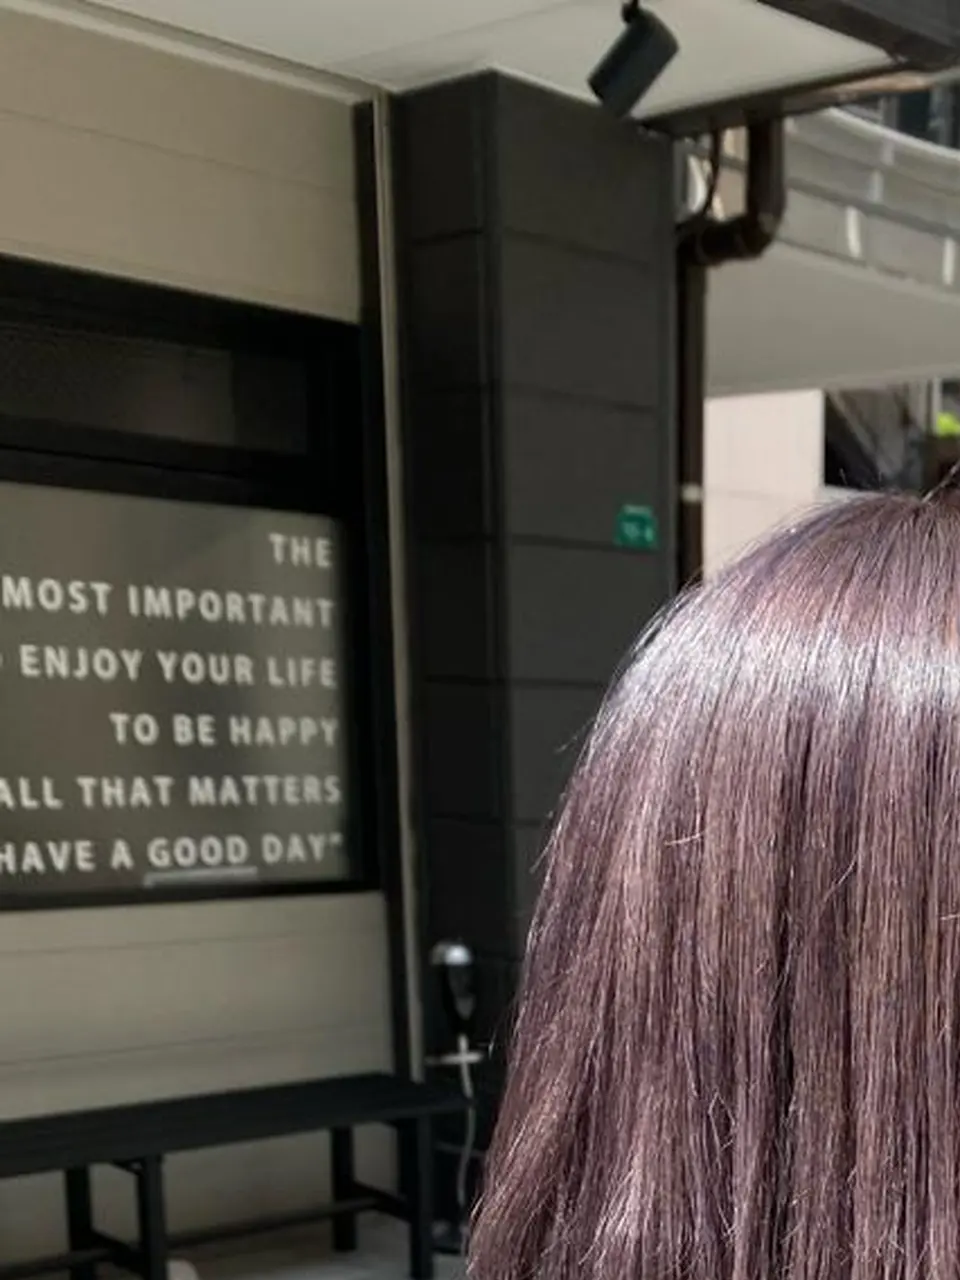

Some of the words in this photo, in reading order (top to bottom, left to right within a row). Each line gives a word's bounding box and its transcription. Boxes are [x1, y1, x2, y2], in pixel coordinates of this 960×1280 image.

[269, 533, 332, 568] THE
[2, 574, 112, 615] MOST
[128, 584, 334, 628] IMPORTANT
[20, 644, 143, 682] ENJOY
[157, 651, 253, 685] YOUR
[268, 657, 337, 688] LIFE
[109, 713, 159, 746] TO
[173, 714, 215, 746] BE
[229, 715, 337, 747] HAPPY
[0, 776, 63, 810] ALL
[76, 776, 174, 808] THAT
[188, 775, 341, 807] MATTERS
[0, 840, 96, 874] HAVE
[111, 838, 134, 870] A
[147, 833, 249, 869] GOOD
